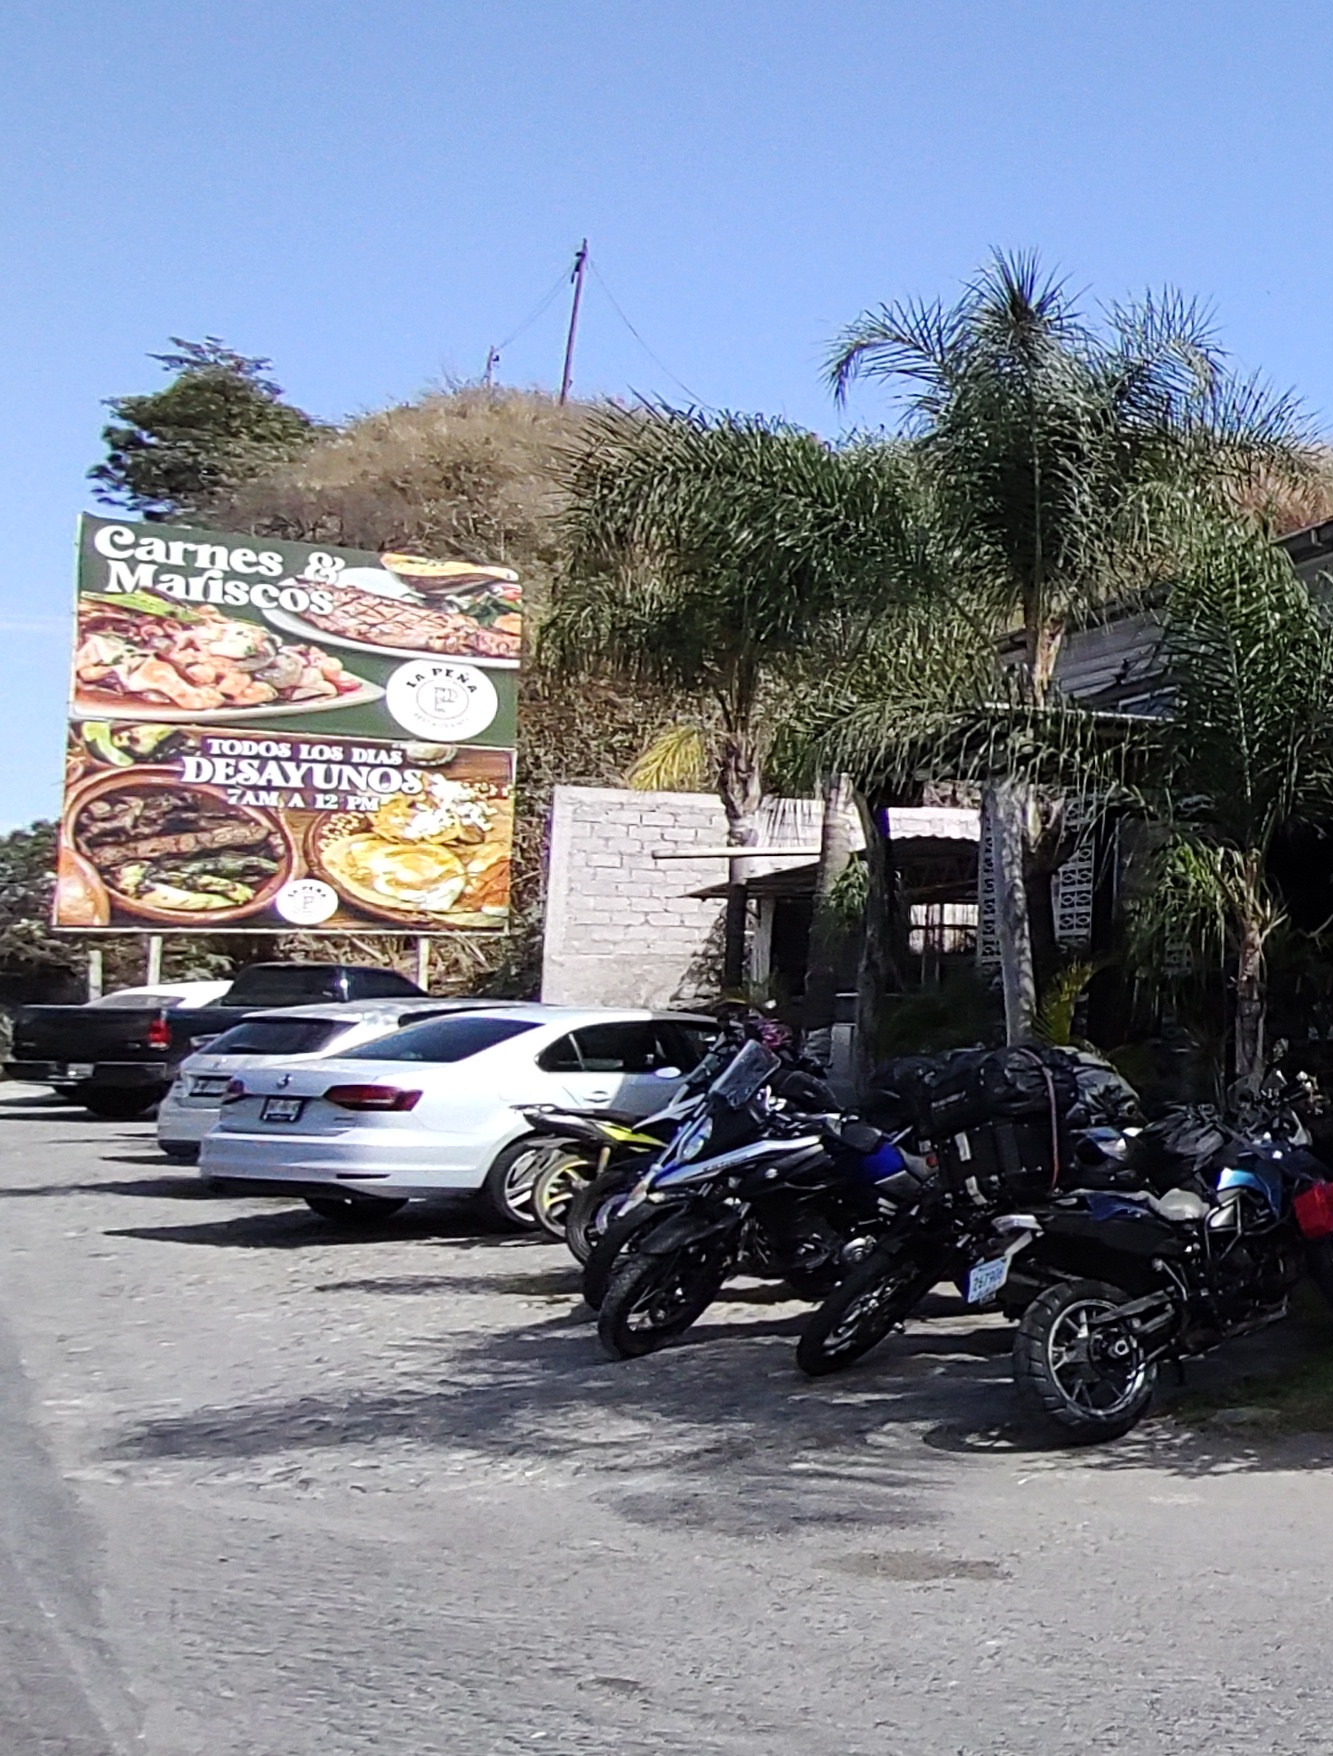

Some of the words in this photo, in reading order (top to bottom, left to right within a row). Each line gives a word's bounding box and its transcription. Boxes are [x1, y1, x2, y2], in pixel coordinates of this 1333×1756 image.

[94, 525, 284, 576] Carnes
[304, 552, 346, 586] &
[104, 560, 335, 616] Mariscos
[432, 668, 477, 693] PEÑA
[207, 739, 291, 758] TODOS
[299, 744, 344, 761] LOS
[351, 748, 403, 765] DIAS
[181, 756, 424, 794] DESAYUNOS
[227, 789, 280, 807] 7AM
[288, 793, 305, 808] A
[315, 793, 339, 810] 12
[347, 795, 380, 812] PM
